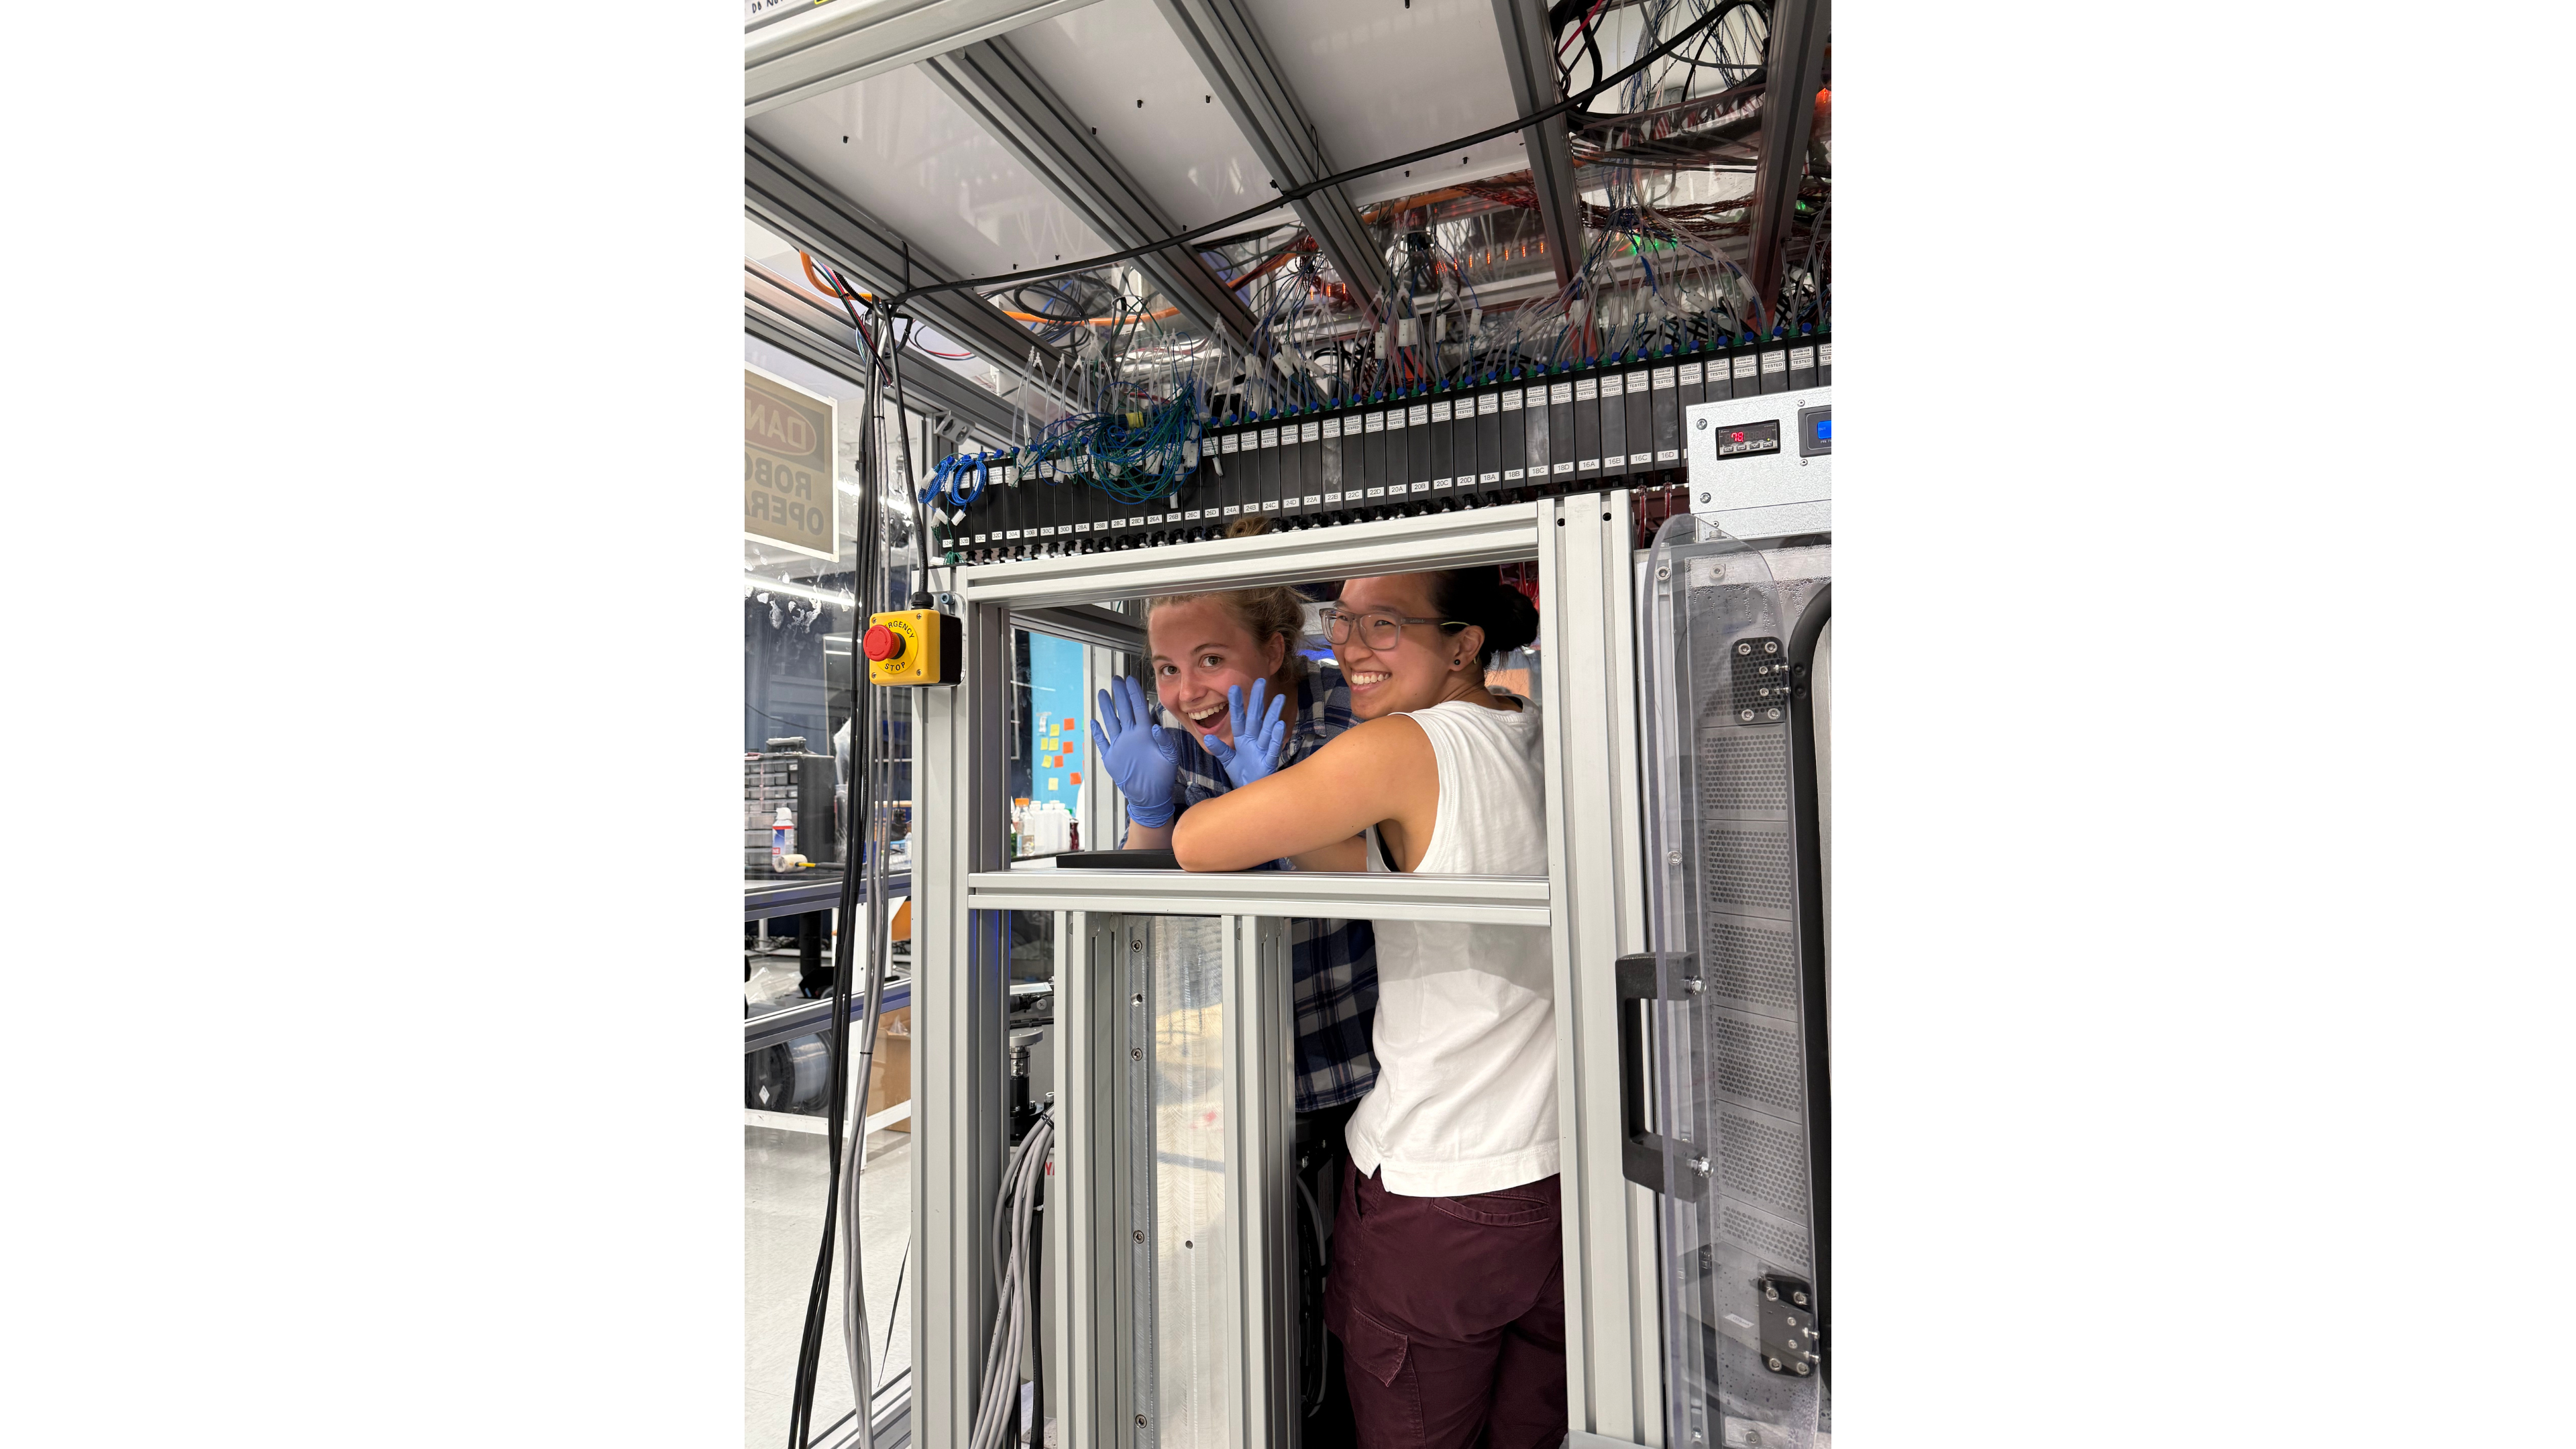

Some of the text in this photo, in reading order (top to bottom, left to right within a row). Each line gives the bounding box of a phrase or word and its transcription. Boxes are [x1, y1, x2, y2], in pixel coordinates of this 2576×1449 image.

[751, 1, 762, 13] DO
[884, 621, 915, 639] RGENCY
[884, 661, 906, 671] STOP
[1044, 1162, 1055, 1175] Y
